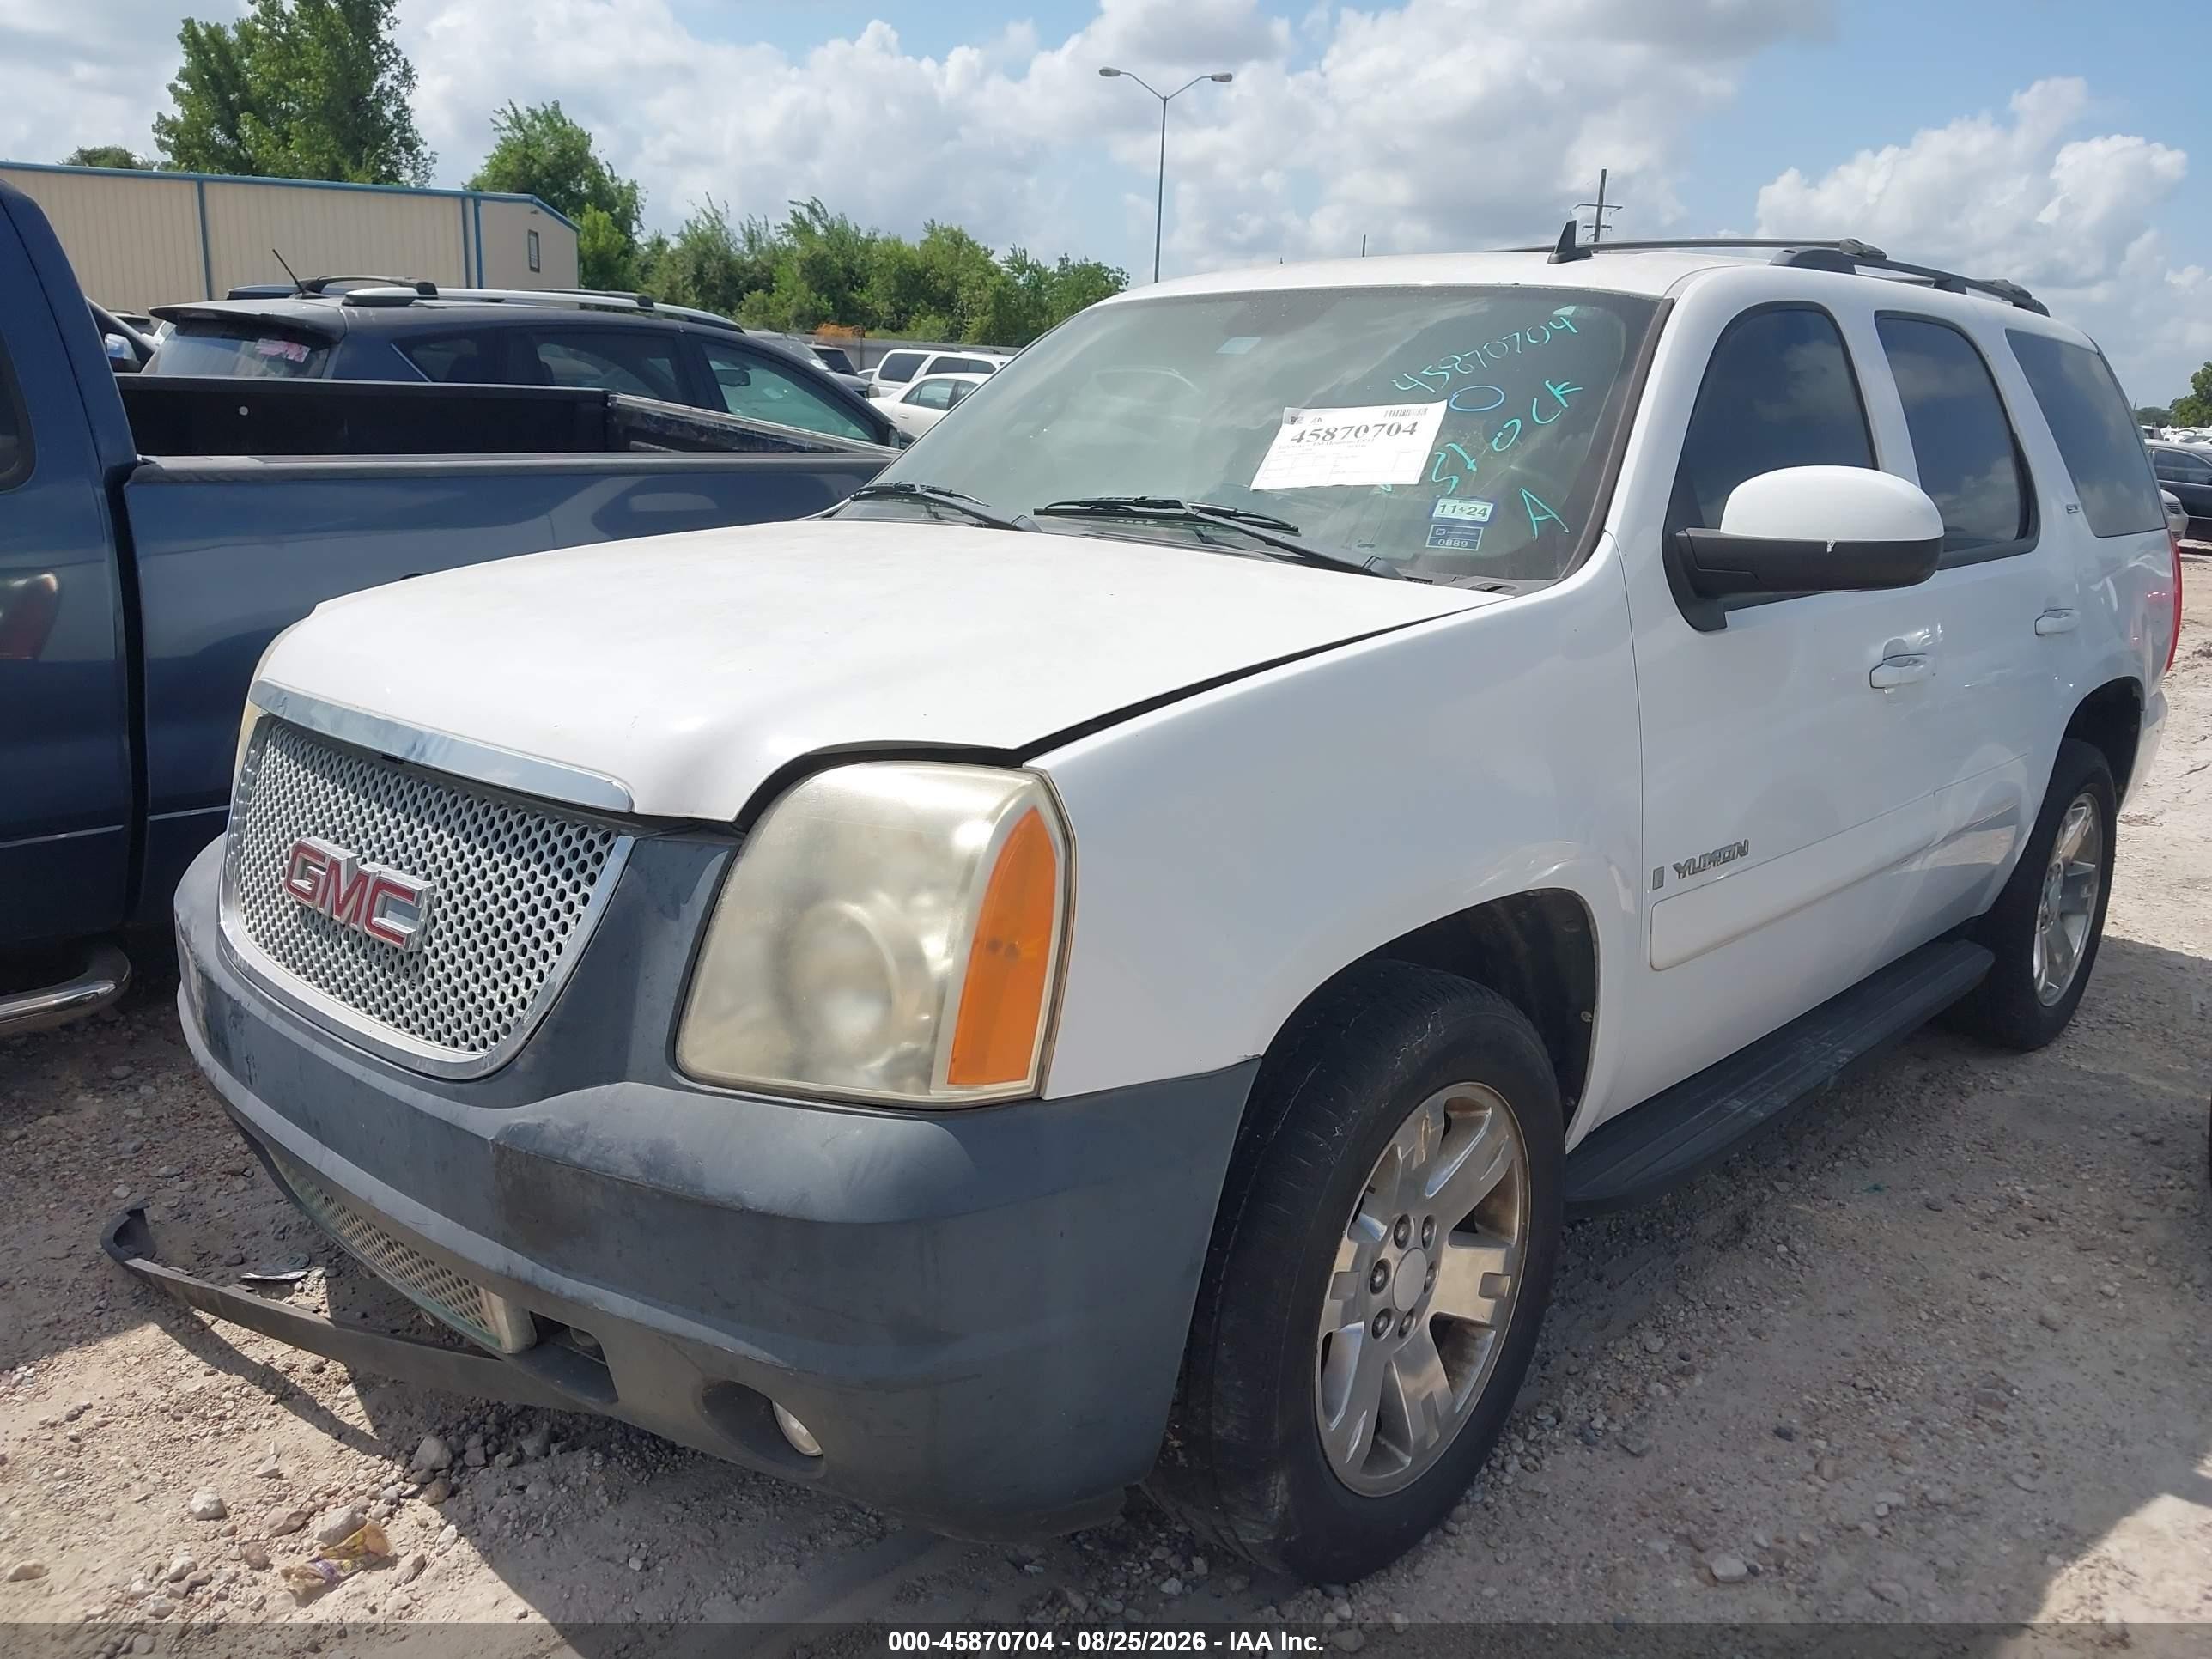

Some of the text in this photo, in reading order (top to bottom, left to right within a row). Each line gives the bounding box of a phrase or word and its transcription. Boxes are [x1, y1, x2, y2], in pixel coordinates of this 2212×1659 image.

[1390, 316, 1578, 393] 45870704
[1290, 421, 1419, 444] 45870704
[1518, 487, 1571, 541] A
[283, 836, 436, 952] GMC
